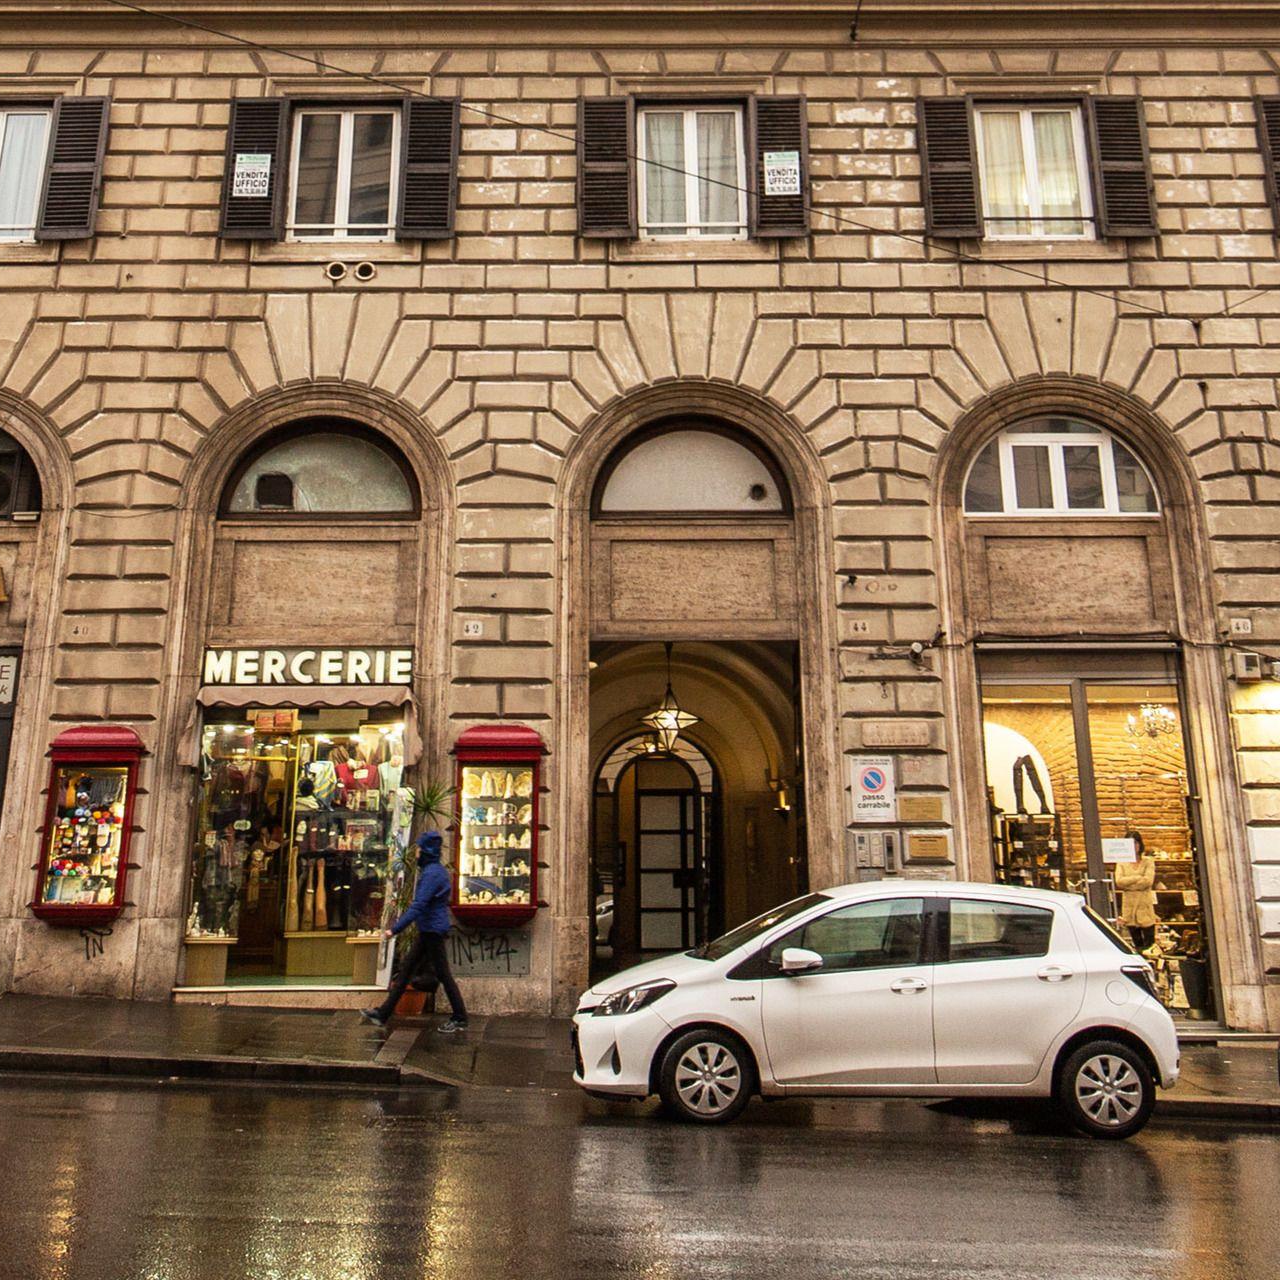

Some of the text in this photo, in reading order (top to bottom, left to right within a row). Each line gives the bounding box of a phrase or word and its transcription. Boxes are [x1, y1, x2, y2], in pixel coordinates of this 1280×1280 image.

[236, 171, 268, 179] VENDITA
[767, 168, 798, 177] VENDITA
[235, 179, 267, 188] UFFICIO
[768, 176, 797, 185] UFFICIO
[204, 649, 412, 684] MERCERIE
